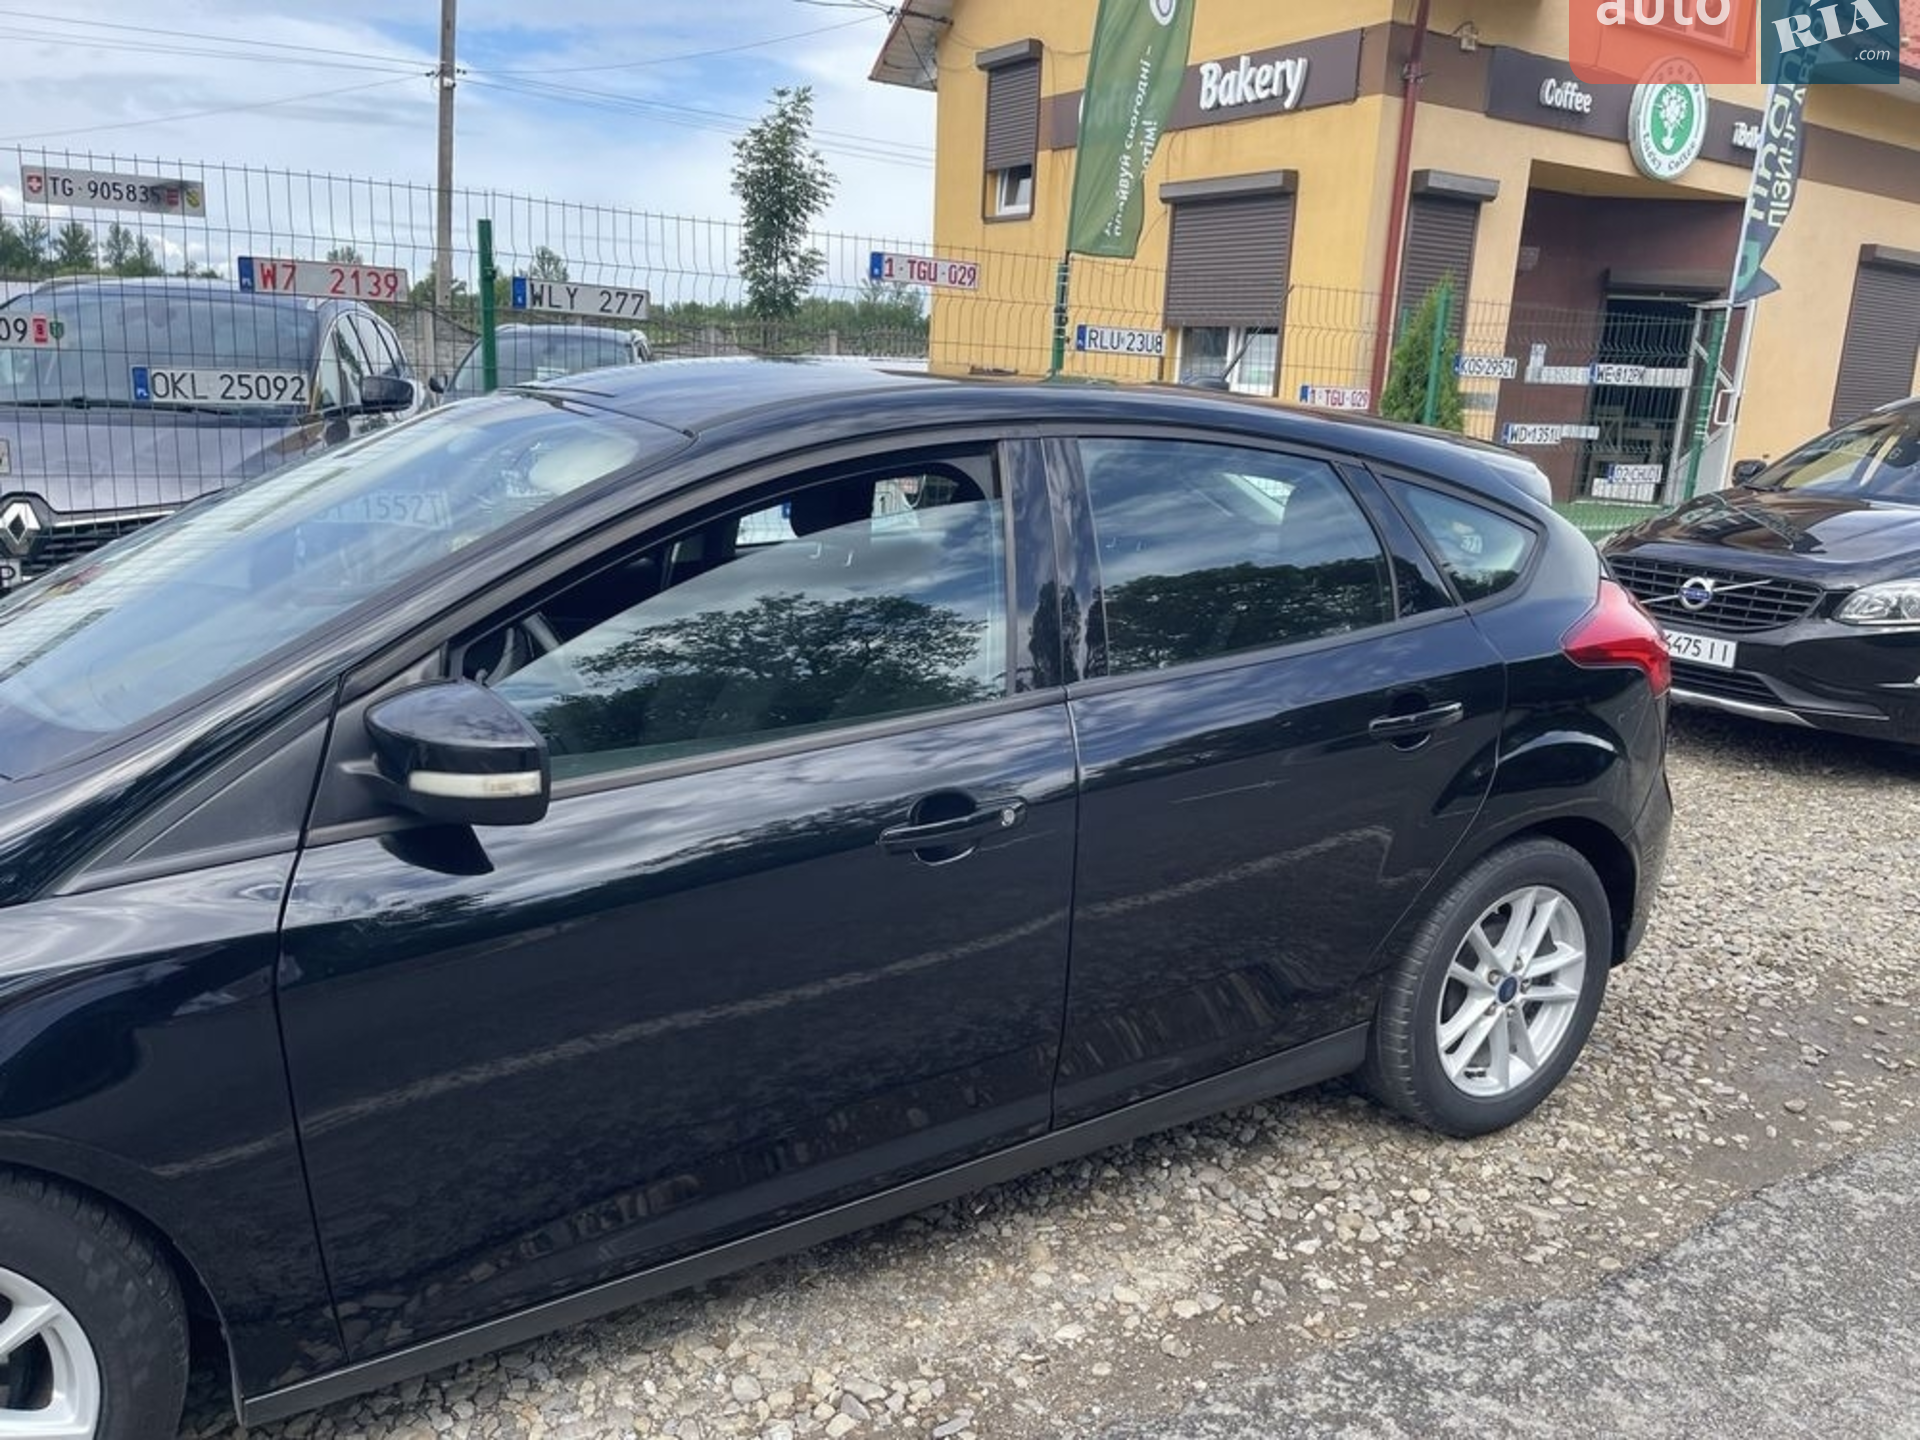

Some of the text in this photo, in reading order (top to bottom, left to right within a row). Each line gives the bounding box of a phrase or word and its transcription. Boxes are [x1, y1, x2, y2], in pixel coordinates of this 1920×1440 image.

[1200, 56, 1307, 110] Bakery
[1540, 78, 1592, 113] Coffee
[260, 262, 297, 291] W7
[330, 267, 399, 299] 2139
[530, 282, 645, 317] WLY 277
[1088, 328, 1121, 351] RLU
[151, 372, 208, 399] OKL
[219, 373, 306, 402] 25092
